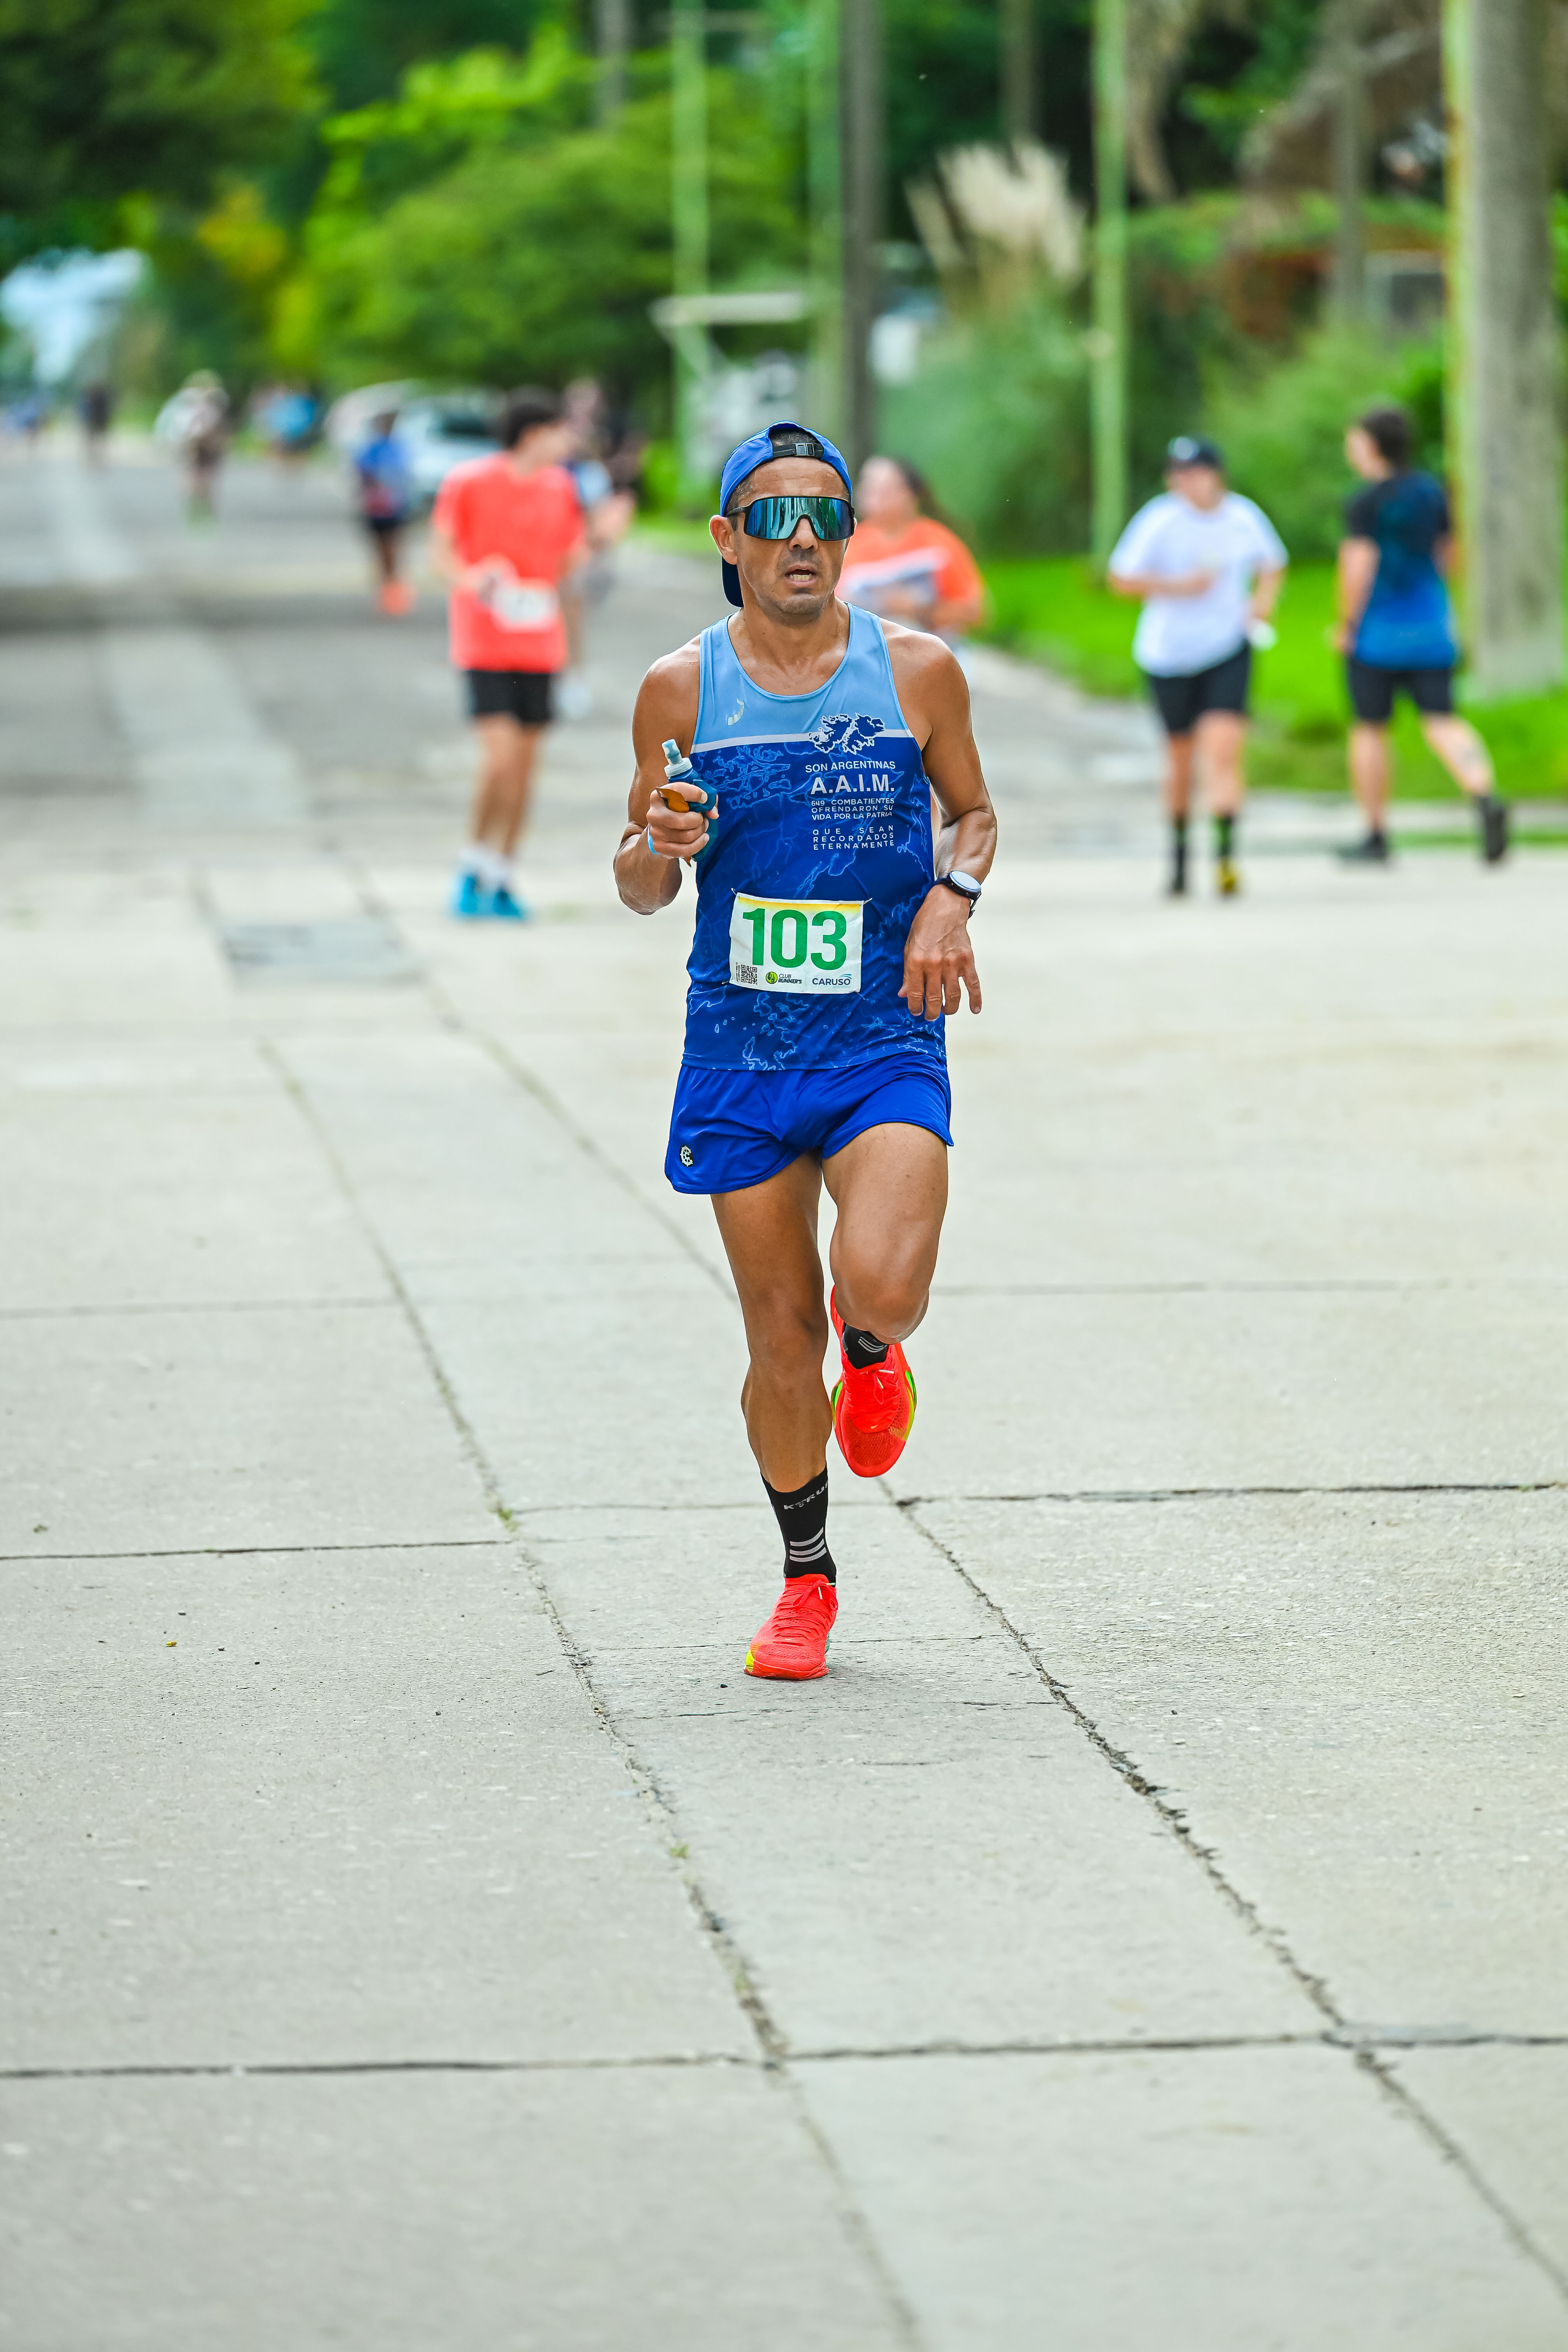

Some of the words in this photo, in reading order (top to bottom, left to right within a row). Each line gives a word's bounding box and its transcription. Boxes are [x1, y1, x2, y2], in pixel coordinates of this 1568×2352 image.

[805, 763, 828, 773] SON
[831, 761, 896, 770] ARGENTINAS
[810, 774, 894, 794] A.A.I.M.
[859, 825, 894, 834] SEAN
[814, 833, 894, 843] RECORDADOS
[814, 840, 894, 850] ETERNAMENTE
[742, 908, 847, 970] 103
